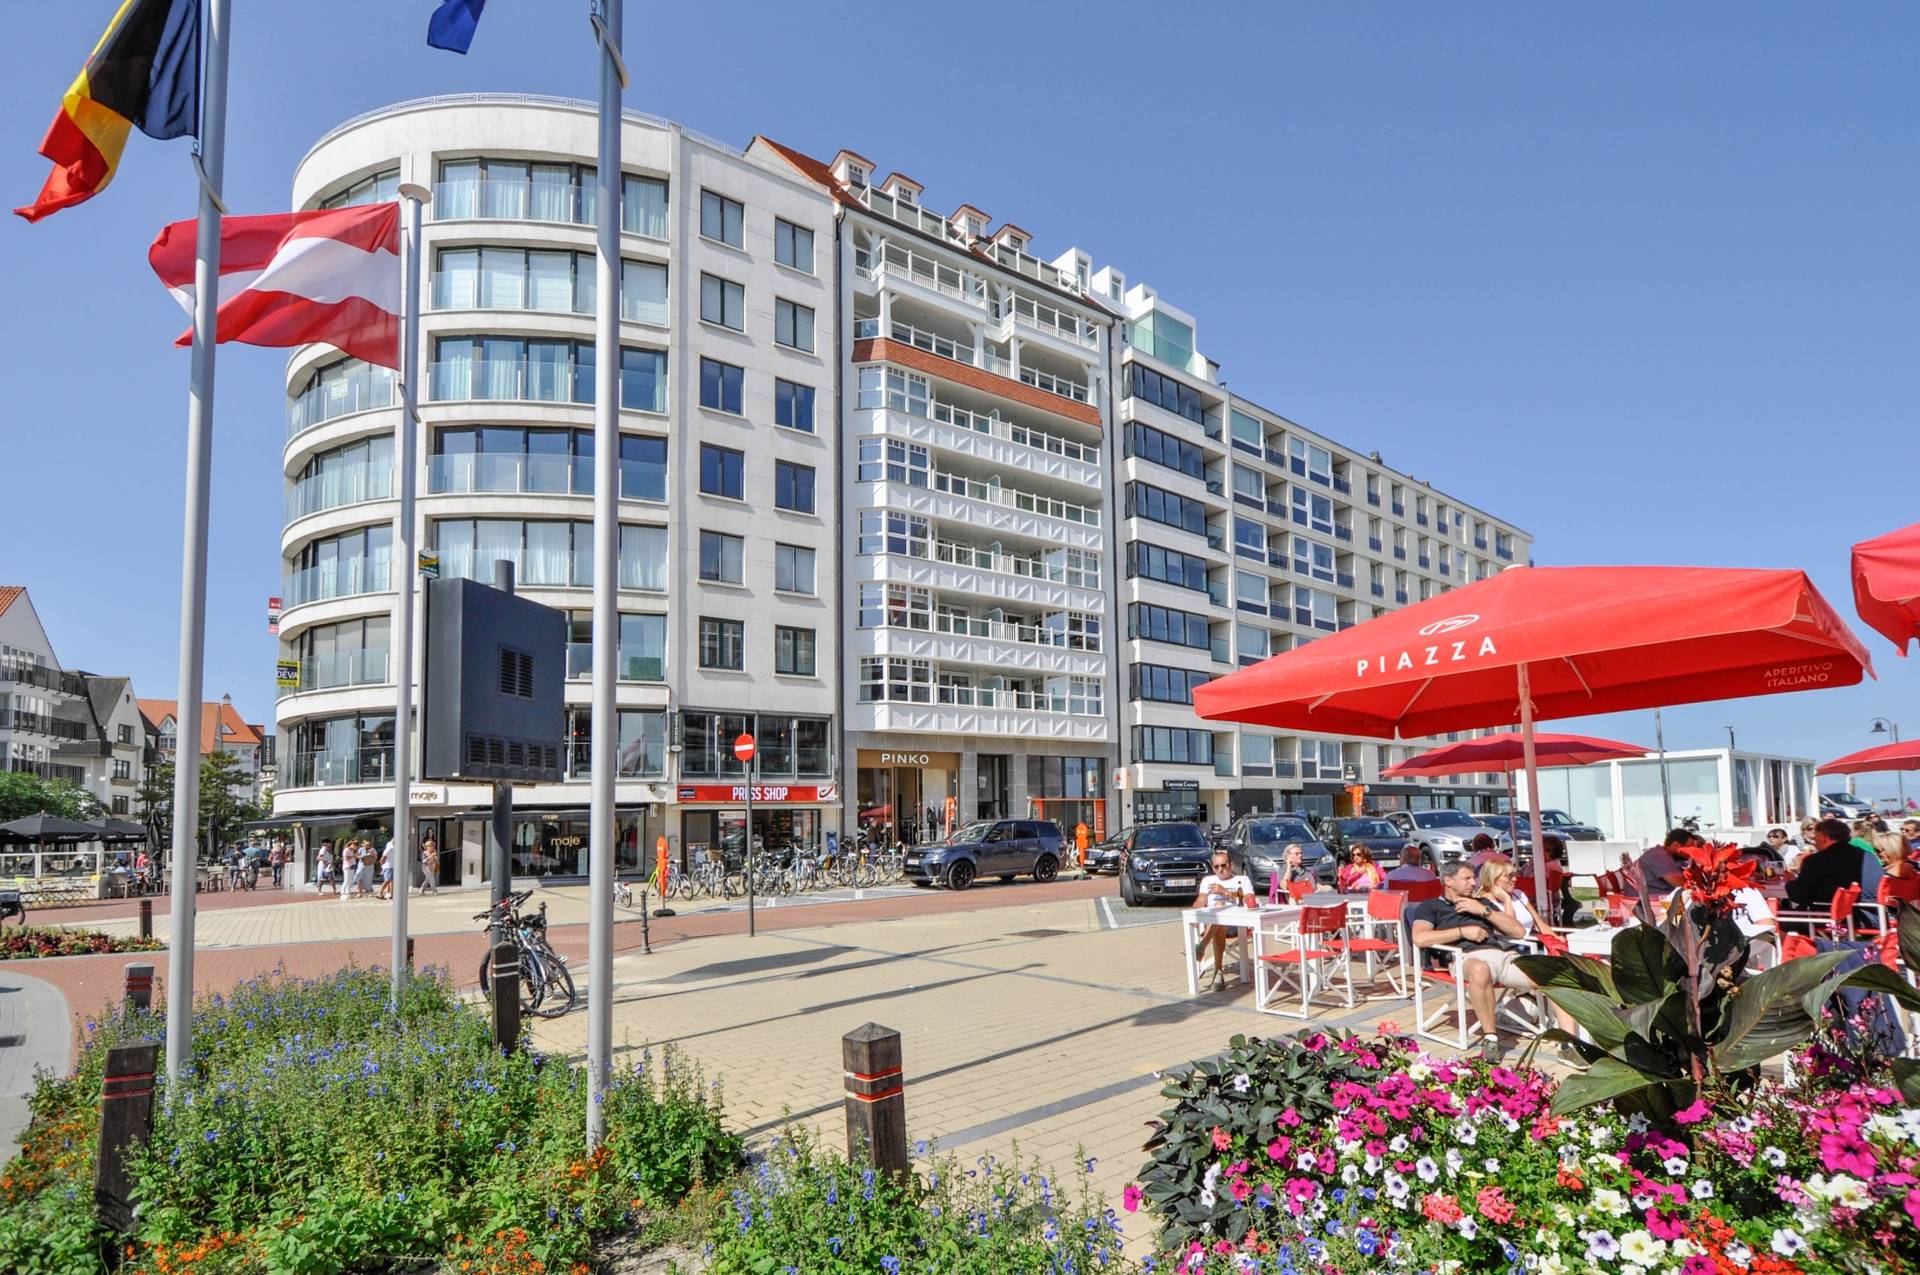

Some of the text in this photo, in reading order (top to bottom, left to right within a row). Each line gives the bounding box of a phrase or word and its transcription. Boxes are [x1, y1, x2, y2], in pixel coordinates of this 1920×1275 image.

[1356, 636, 1497, 678] PIAZZA
[1763, 662, 1832, 678] APERITIVO
[1767, 673, 1828, 688] ITALIANO
[881, 753, 929, 765] PINKO
[411, 790, 438, 801] maje
[763, 786, 788, 801] SHOP
[551, 836, 581, 847] maje
